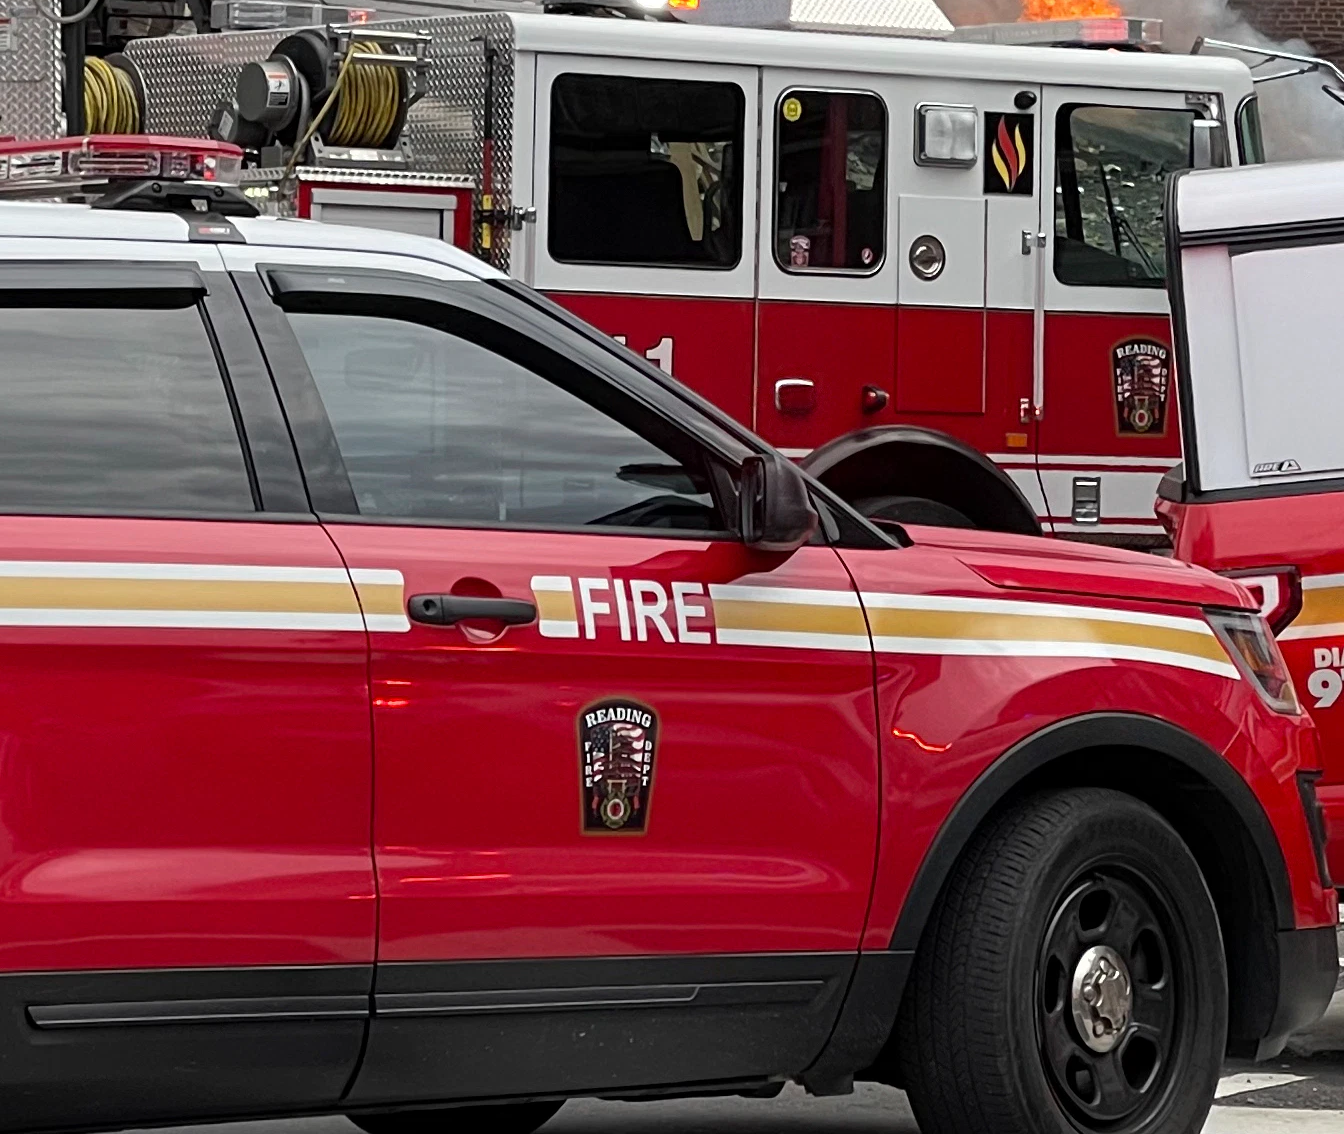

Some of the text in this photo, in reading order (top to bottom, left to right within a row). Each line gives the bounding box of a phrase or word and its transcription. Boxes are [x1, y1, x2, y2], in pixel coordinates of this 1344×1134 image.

[1116, 343, 1167, 359] READING
[578, 577, 712, 644] FIRE
[585, 707, 652, 728] READING
[584, 741, 594, 787] FIRE
[641, 740, 653, 786] DEPT
